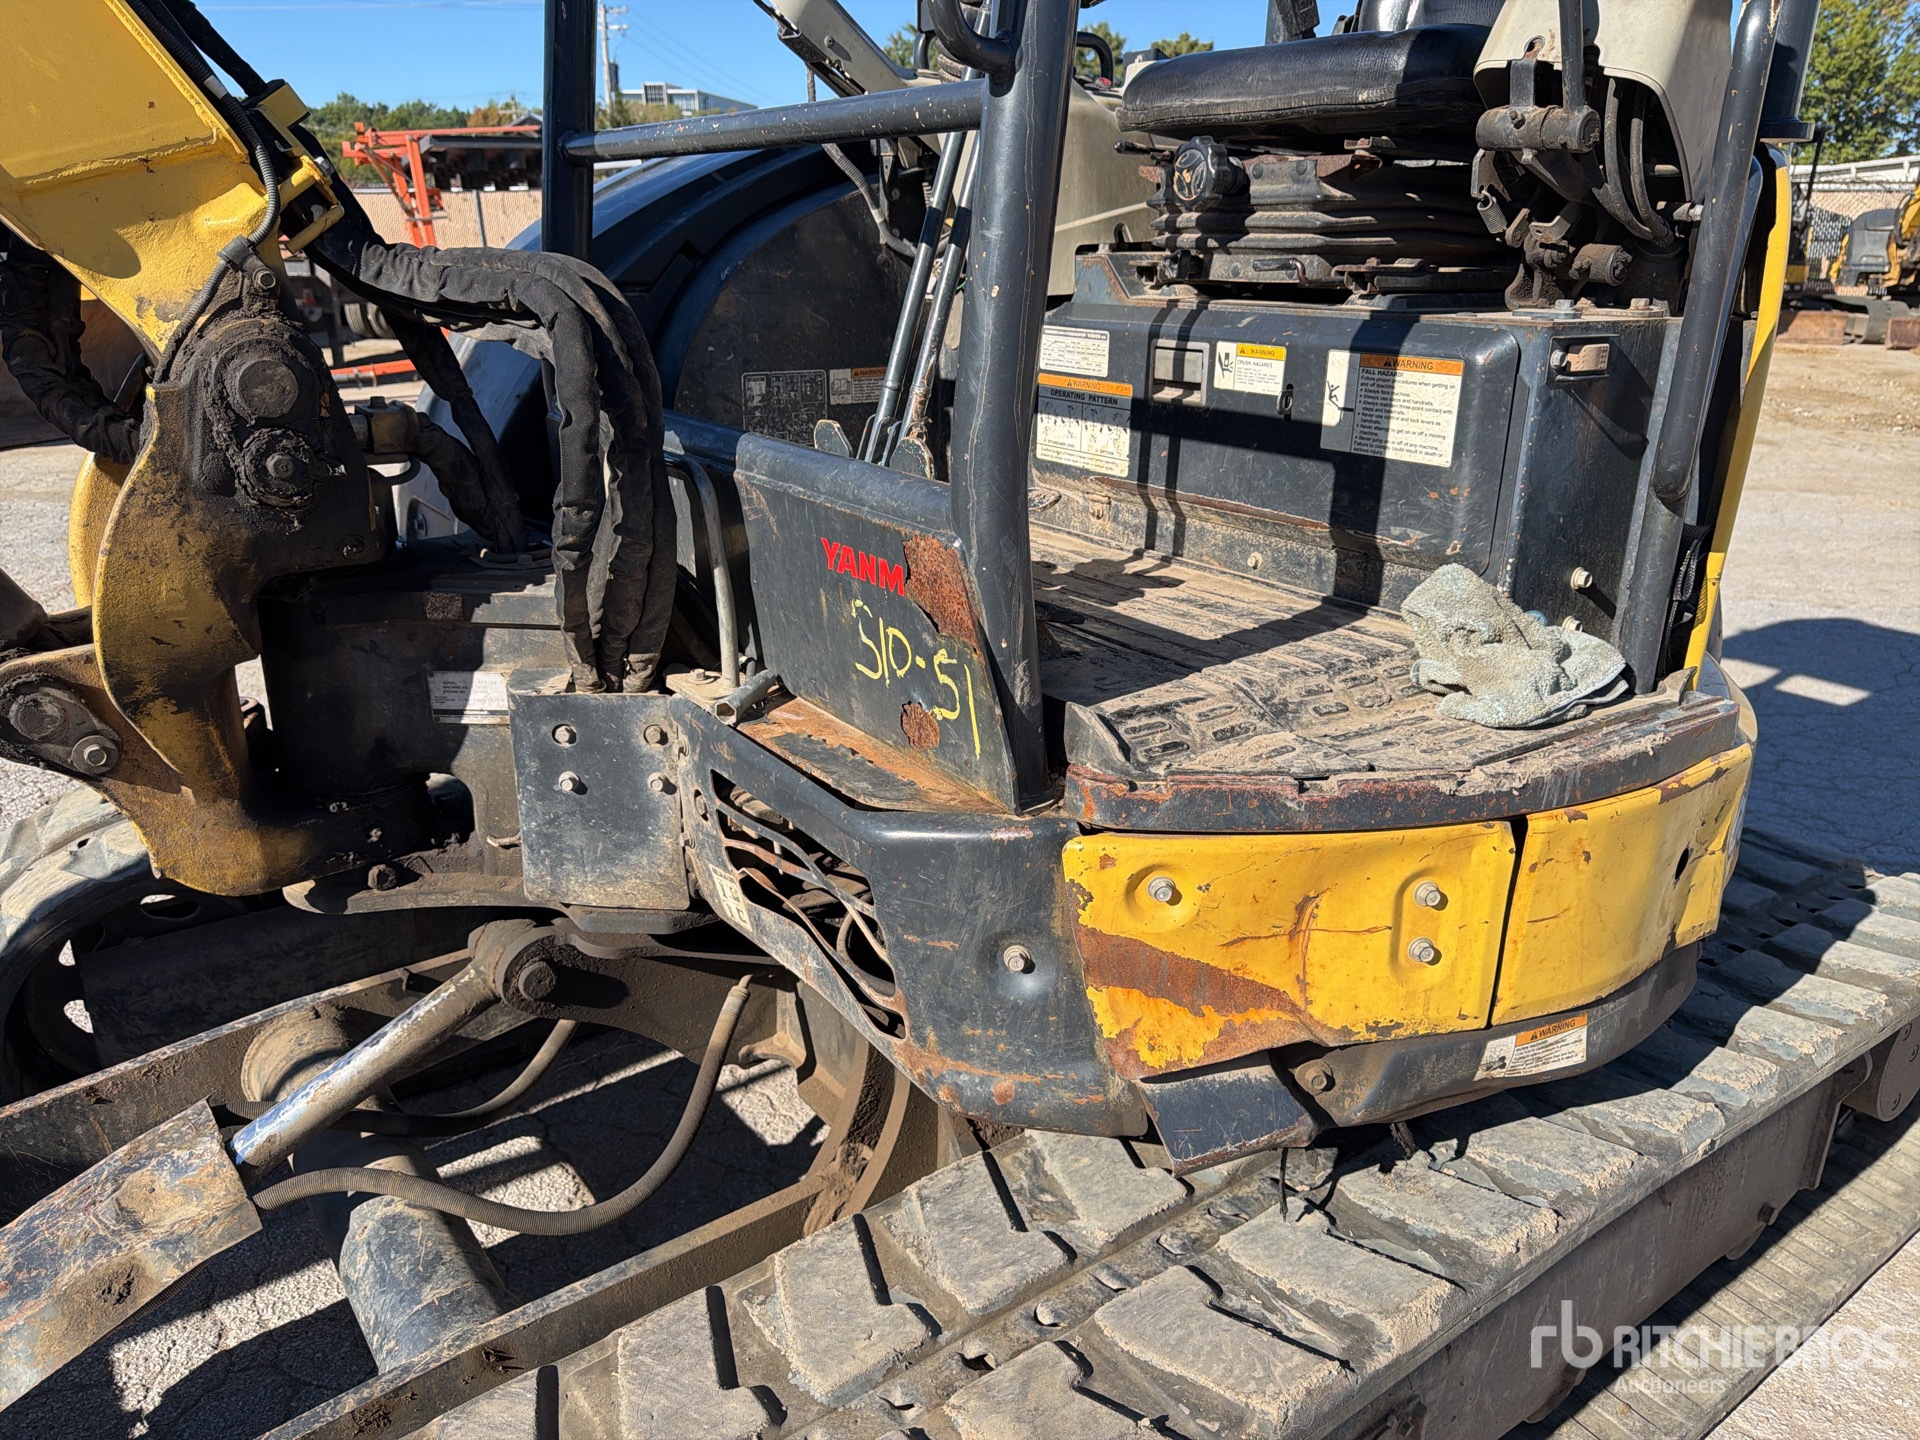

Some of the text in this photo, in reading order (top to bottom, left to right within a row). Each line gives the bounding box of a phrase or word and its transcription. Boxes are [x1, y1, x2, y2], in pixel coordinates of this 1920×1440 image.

[1250, 348, 1275, 357] WARNING
[1392, 358, 1434, 371] WARNING
[1377, 370, 1404, 378] HAZARD!
[1073, 381, 1100, 390] WARNING
[1050, 388, 1118, 406] OPERATING PATTERN
[1539, 1018, 1576, 1038] WARNING
